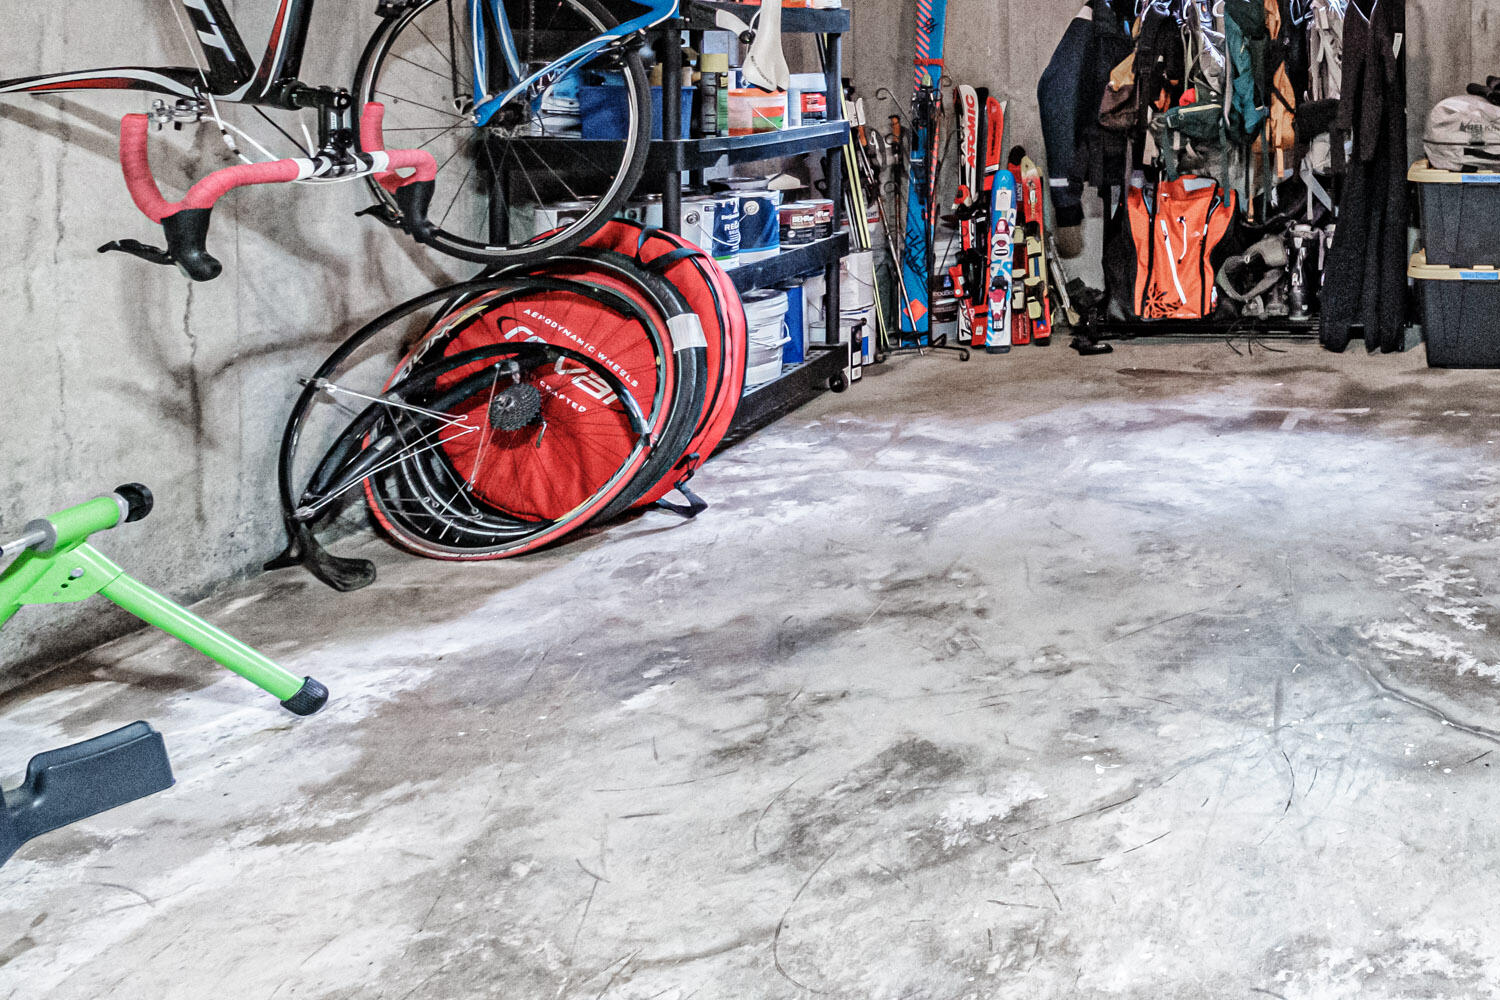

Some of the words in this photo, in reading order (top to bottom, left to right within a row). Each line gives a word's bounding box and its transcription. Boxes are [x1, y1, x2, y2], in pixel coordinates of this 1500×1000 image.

[965, 94, 976, 169] ATOMIC
[523, 308, 596, 354] AERODYNAMIC
[597, 350, 639, 388] WHEELS
[539, 380, 587, 414] CRAFTED
